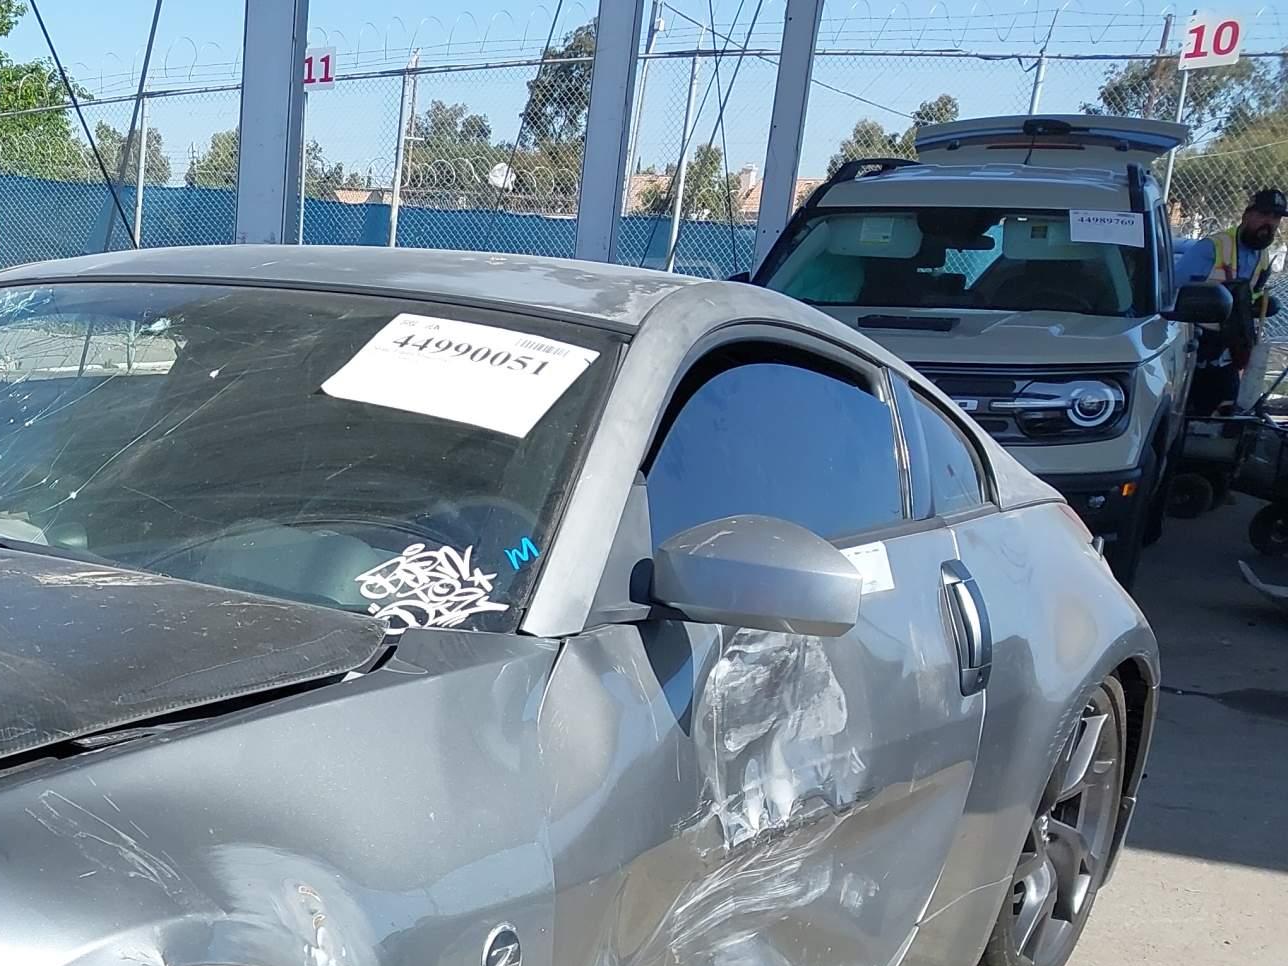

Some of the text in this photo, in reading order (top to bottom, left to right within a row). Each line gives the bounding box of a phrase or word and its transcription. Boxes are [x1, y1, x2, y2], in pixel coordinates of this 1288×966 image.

[1184, 21, 1239, 58] 10
[304, 55, 333, 83] 11
[393, 333, 550, 376] 44990051
